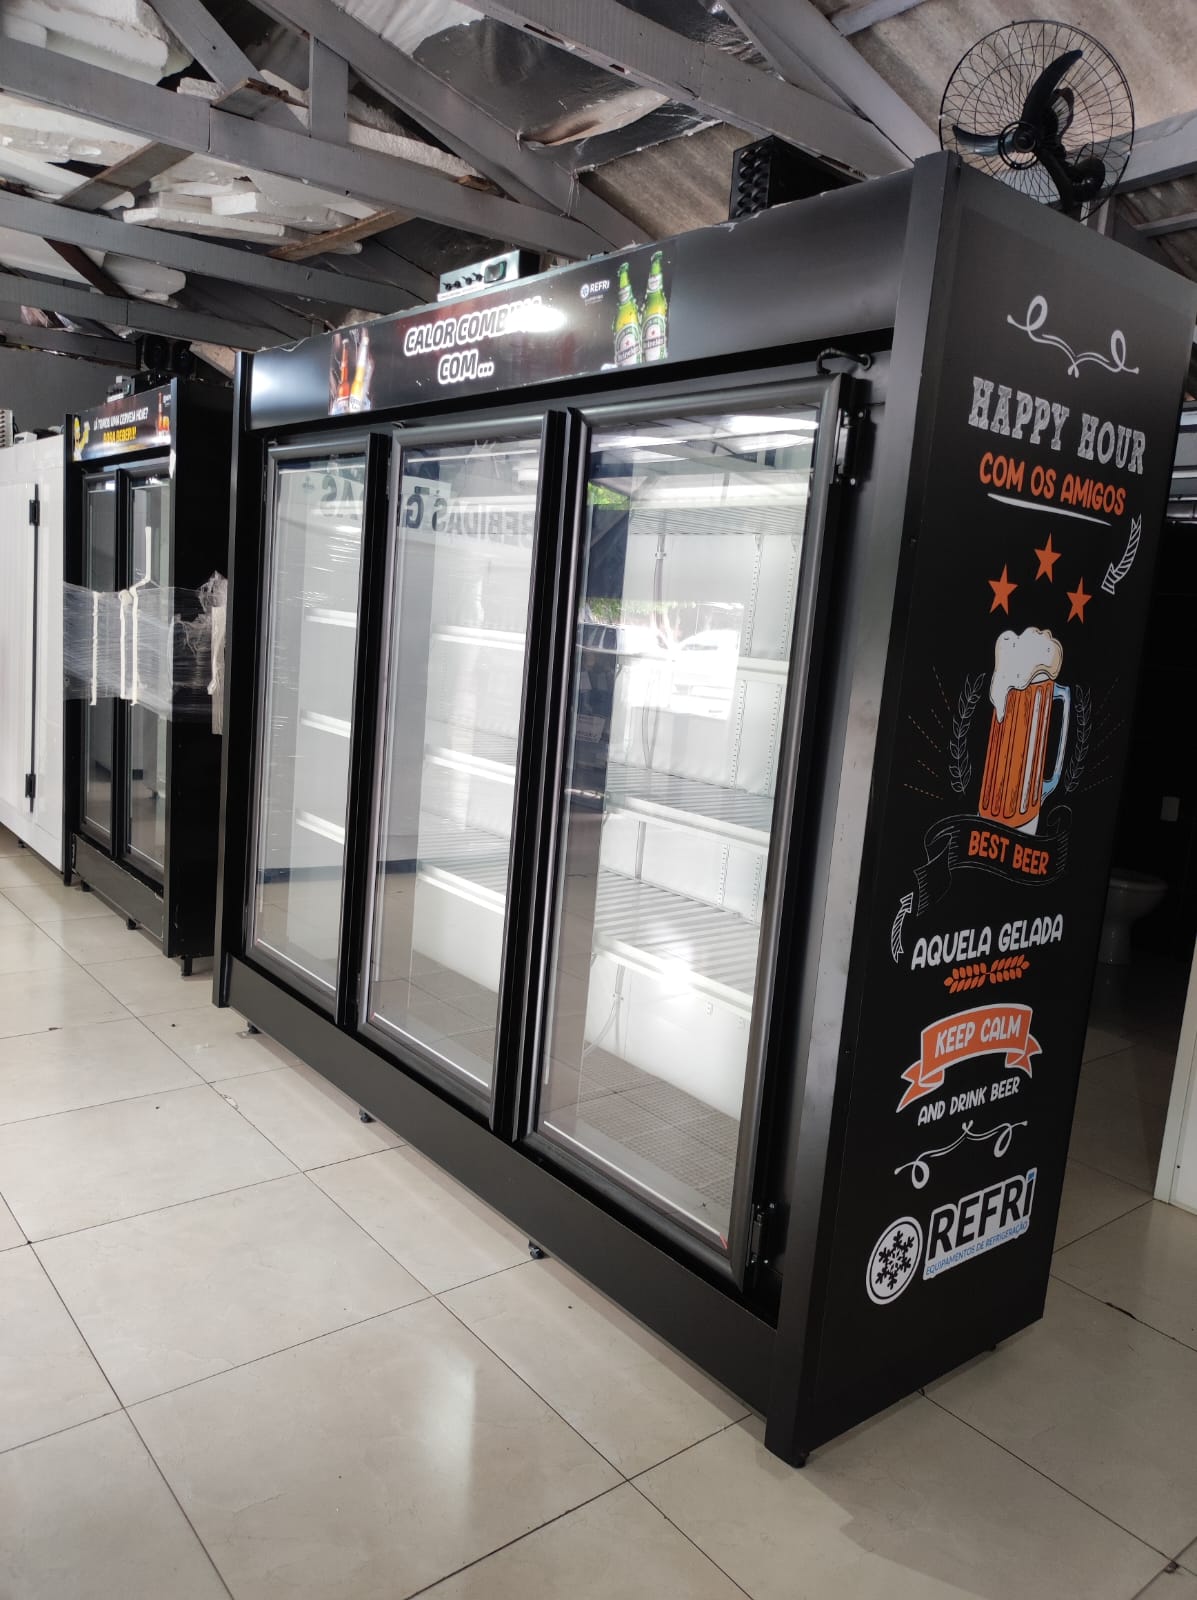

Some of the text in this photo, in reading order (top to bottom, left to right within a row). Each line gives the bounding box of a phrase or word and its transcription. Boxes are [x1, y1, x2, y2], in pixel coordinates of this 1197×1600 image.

[404, 318, 457, 357] CALOR
[968, 376, 1146, 475] HAPPY HOUR
[979, 451, 1127, 516] COM OS AMIGOS
[968, 830, 1050, 875] BEST BEER
[911, 913, 1064, 971] AQUELA GELADA
[934, 1014, 1022, 1059] KEEP CALM
[917, 1076, 1021, 1126] AND DRINK BEER
[926, 1244, 976, 1276] EQUIPAMENTOS
[975, 1241, 985, 1252] DE
